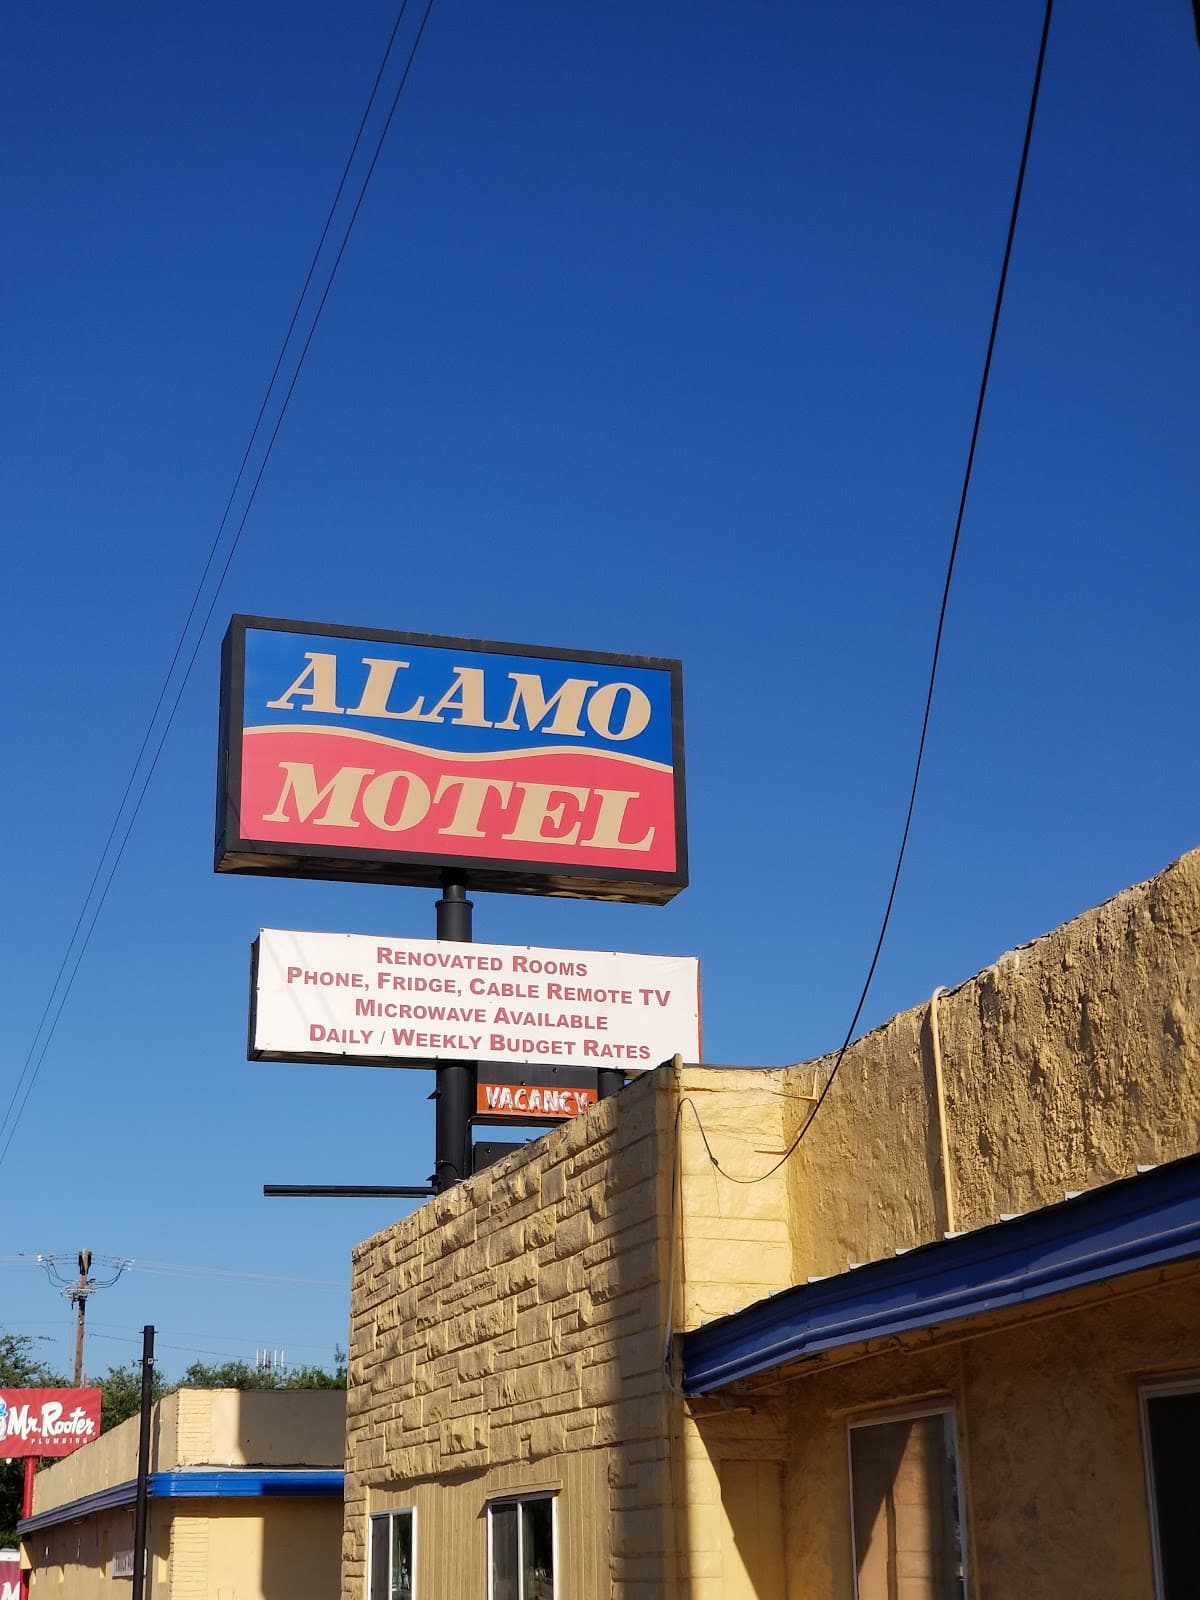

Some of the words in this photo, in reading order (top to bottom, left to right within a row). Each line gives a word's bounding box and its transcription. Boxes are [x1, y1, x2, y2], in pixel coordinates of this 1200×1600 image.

[266, 652, 652, 741] ALAMO
[262, 761, 656, 852] MOTEL
[377, 947, 503, 970] RENOVATED
[512, 955, 588, 977] ROOMS
[469, 978, 540, 999] CABLE
[547, 983, 633, 1005] REMOTE
[639, 988, 671, 1007] TV
[355, 998, 487, 1023] MICROWAVE
[493, 1007, 608, 1030] AVAILABLE
[490, 1033, 576, 1056] BUDGET
[583, 1039, 651, 1060] RATES
[485, 1086, 588, 1113] VACANCY
[41, 1401, 95, 1437] Rooter
[31, 1437, 88, 1445] PLUMBING
